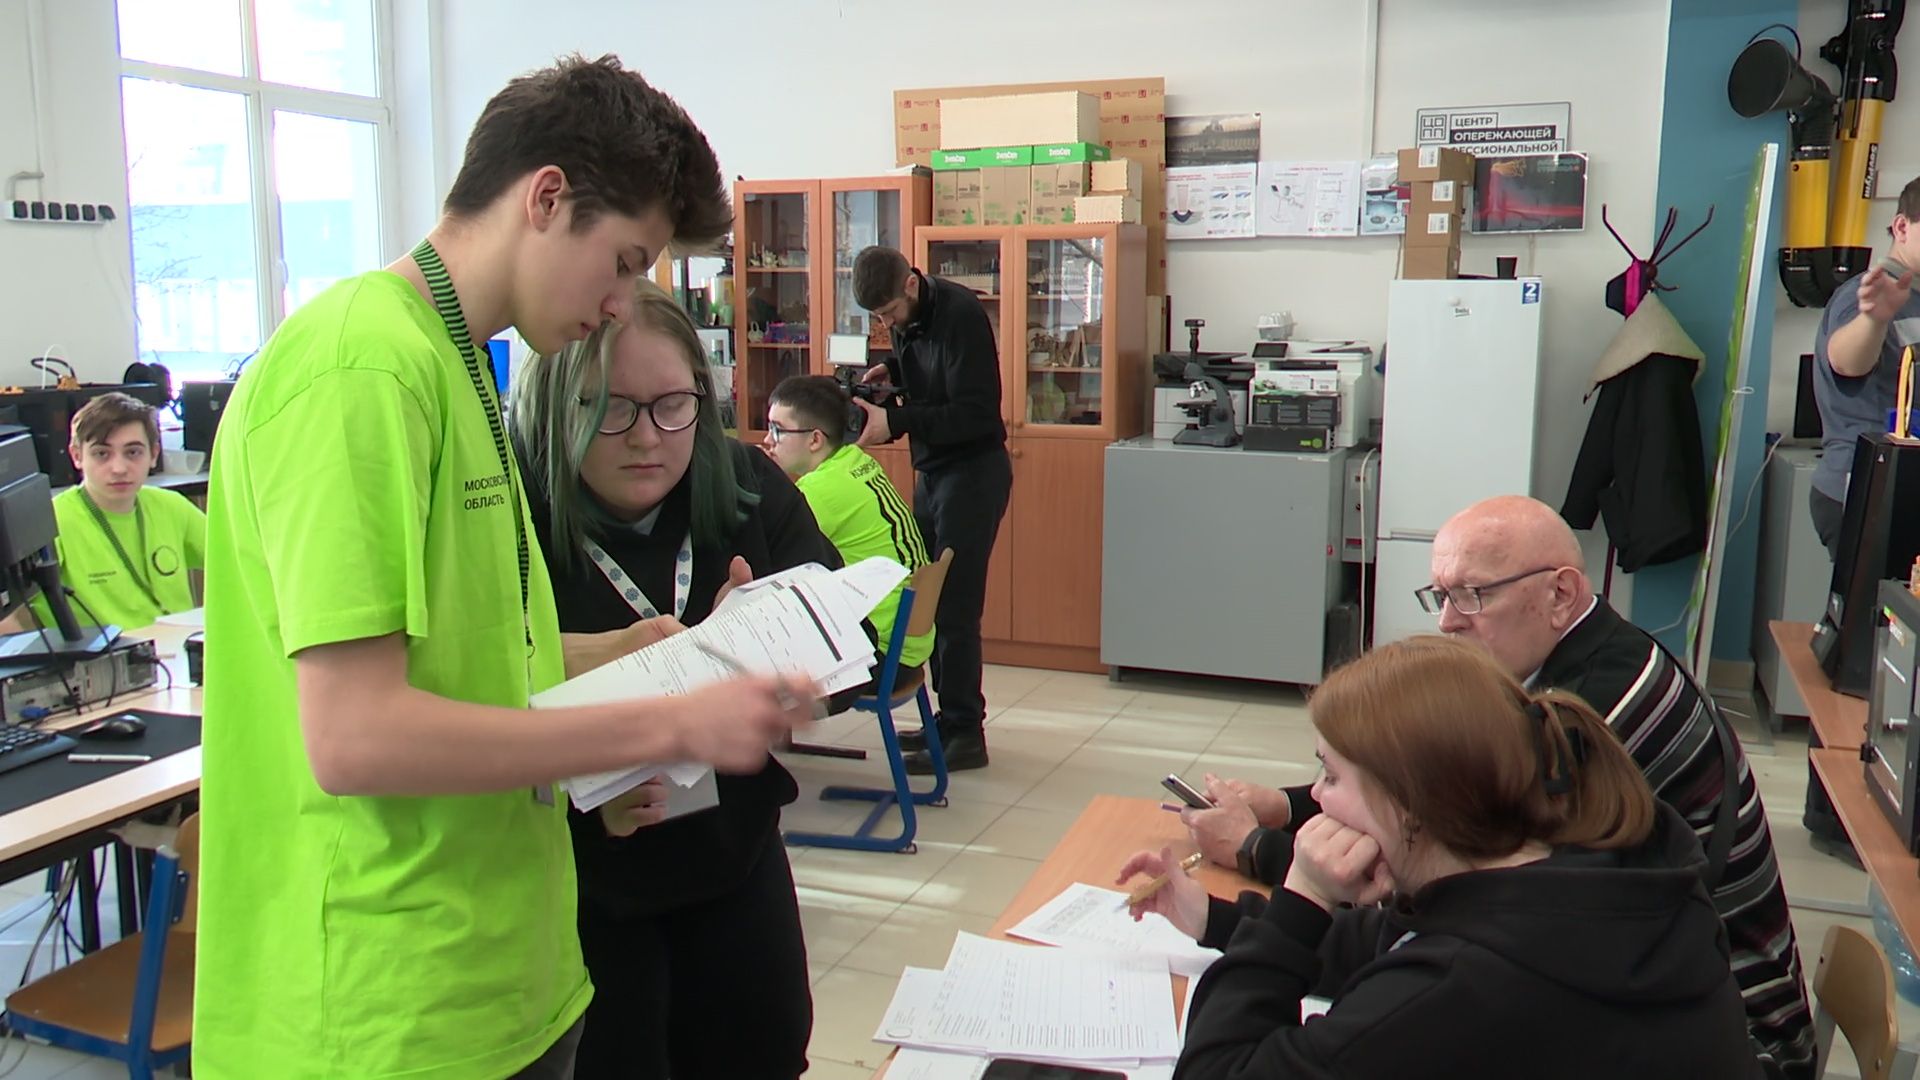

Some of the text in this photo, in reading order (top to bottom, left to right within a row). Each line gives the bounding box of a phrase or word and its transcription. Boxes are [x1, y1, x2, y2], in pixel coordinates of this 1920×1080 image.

[1455, 117, 1493, 127] ЦЕНТР
[1454, 127, 1551, 141] ОПЕРЕЖАЮЩЕЙ
[1454, 141, 1558, 154] ЕССИОНАЛЬНОЙ
[1525, 283, 1537, 297] 2
[464, 494, 505, 510] ОБЛАСТЬ
